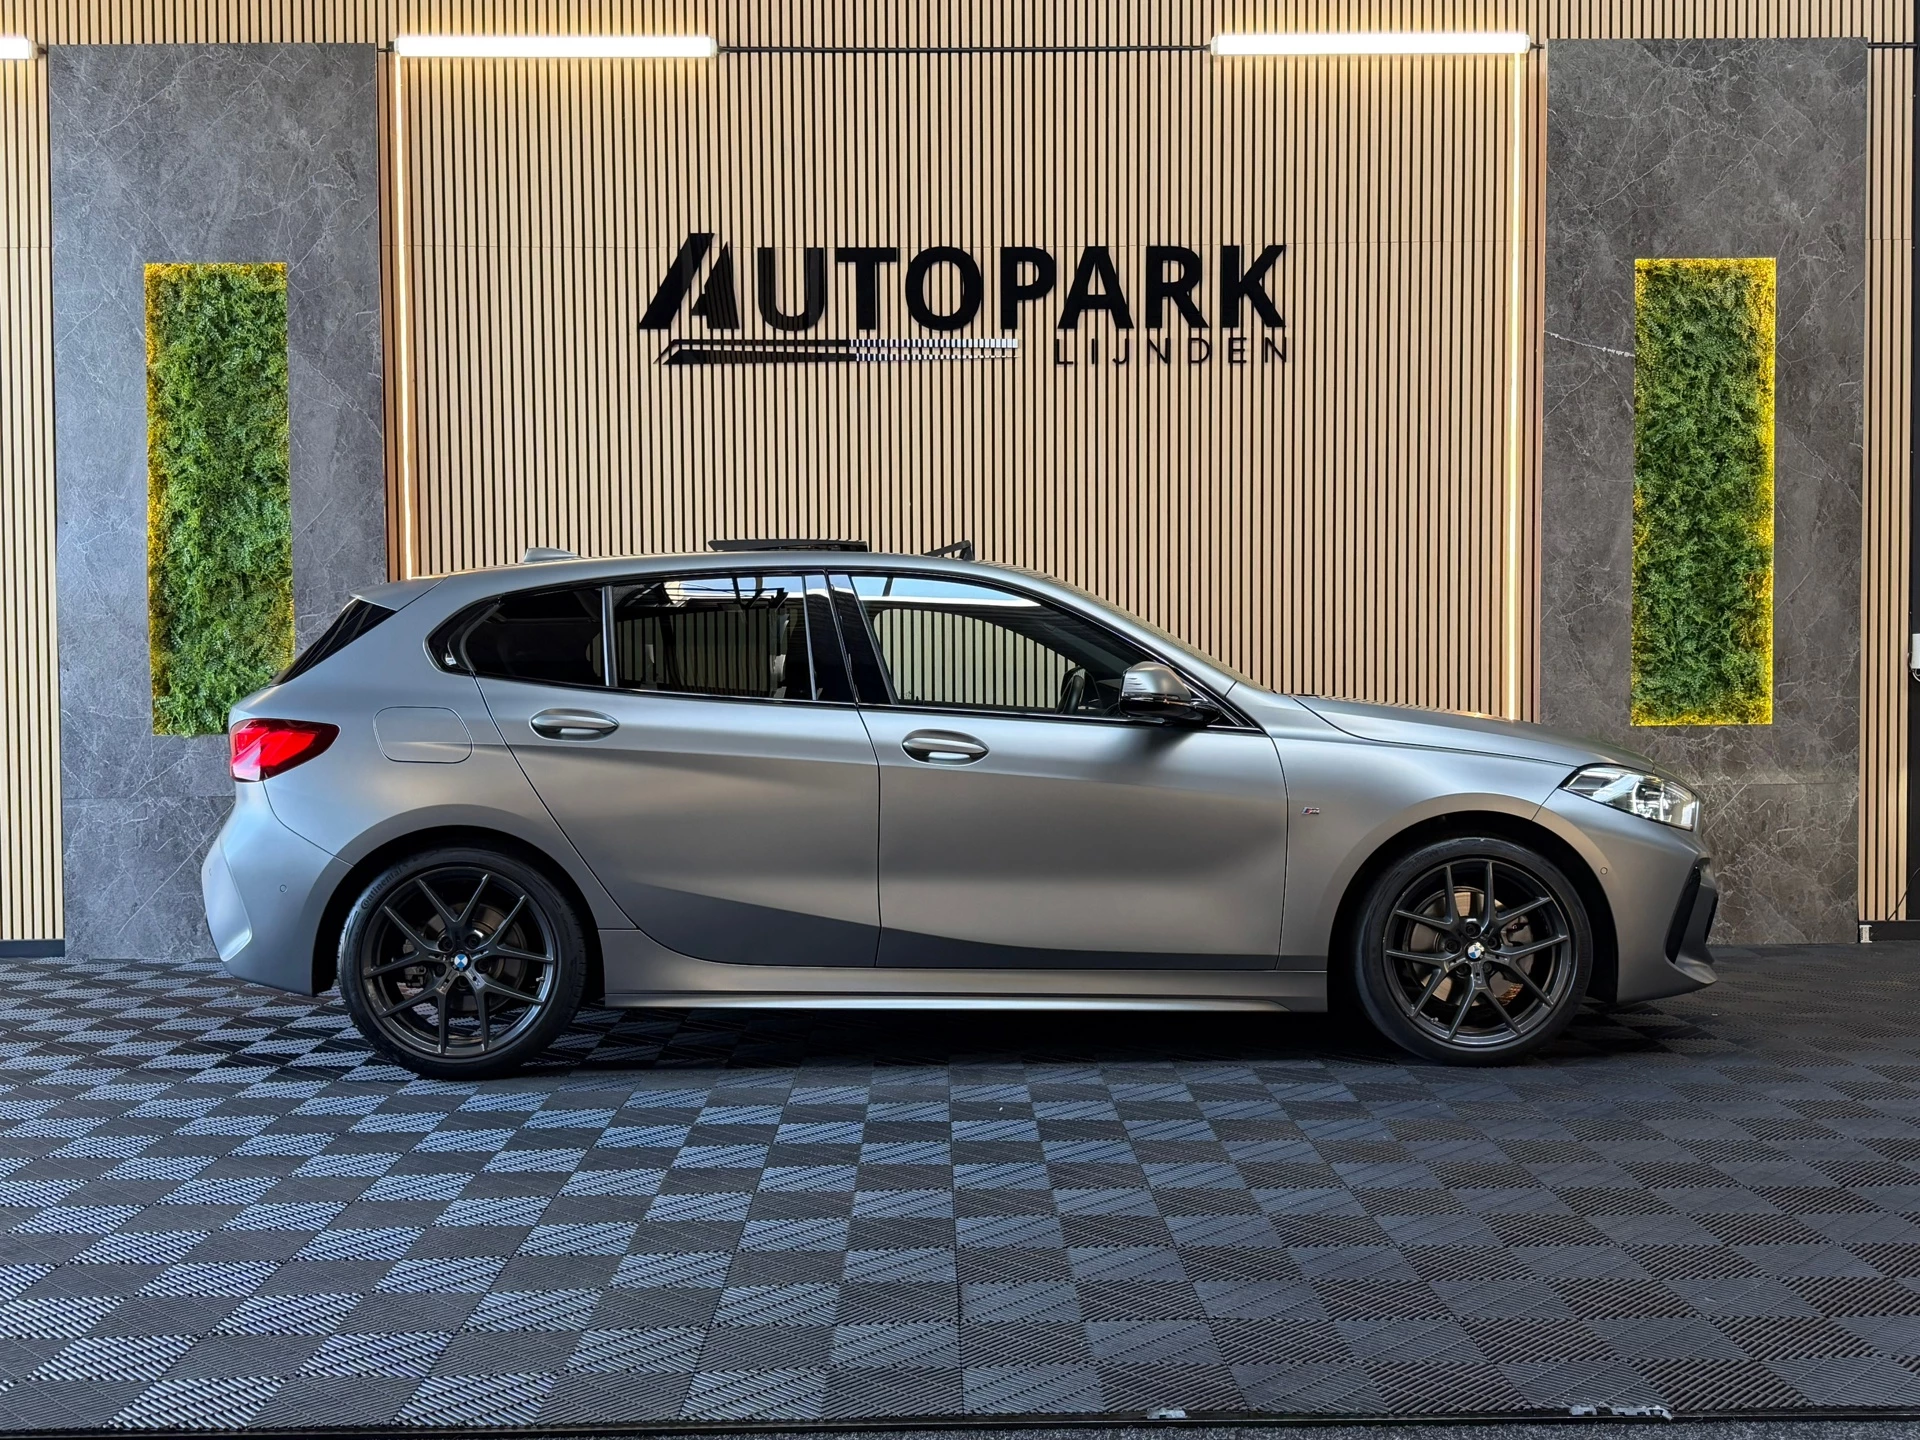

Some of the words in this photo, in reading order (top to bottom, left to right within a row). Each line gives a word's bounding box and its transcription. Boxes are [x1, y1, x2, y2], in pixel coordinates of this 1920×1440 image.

[638, 232, 1287, 331] AUTOPARK
[1056, 337, 1287, 365] LIJNDEN
[361, 866, 402, 910] Continental
